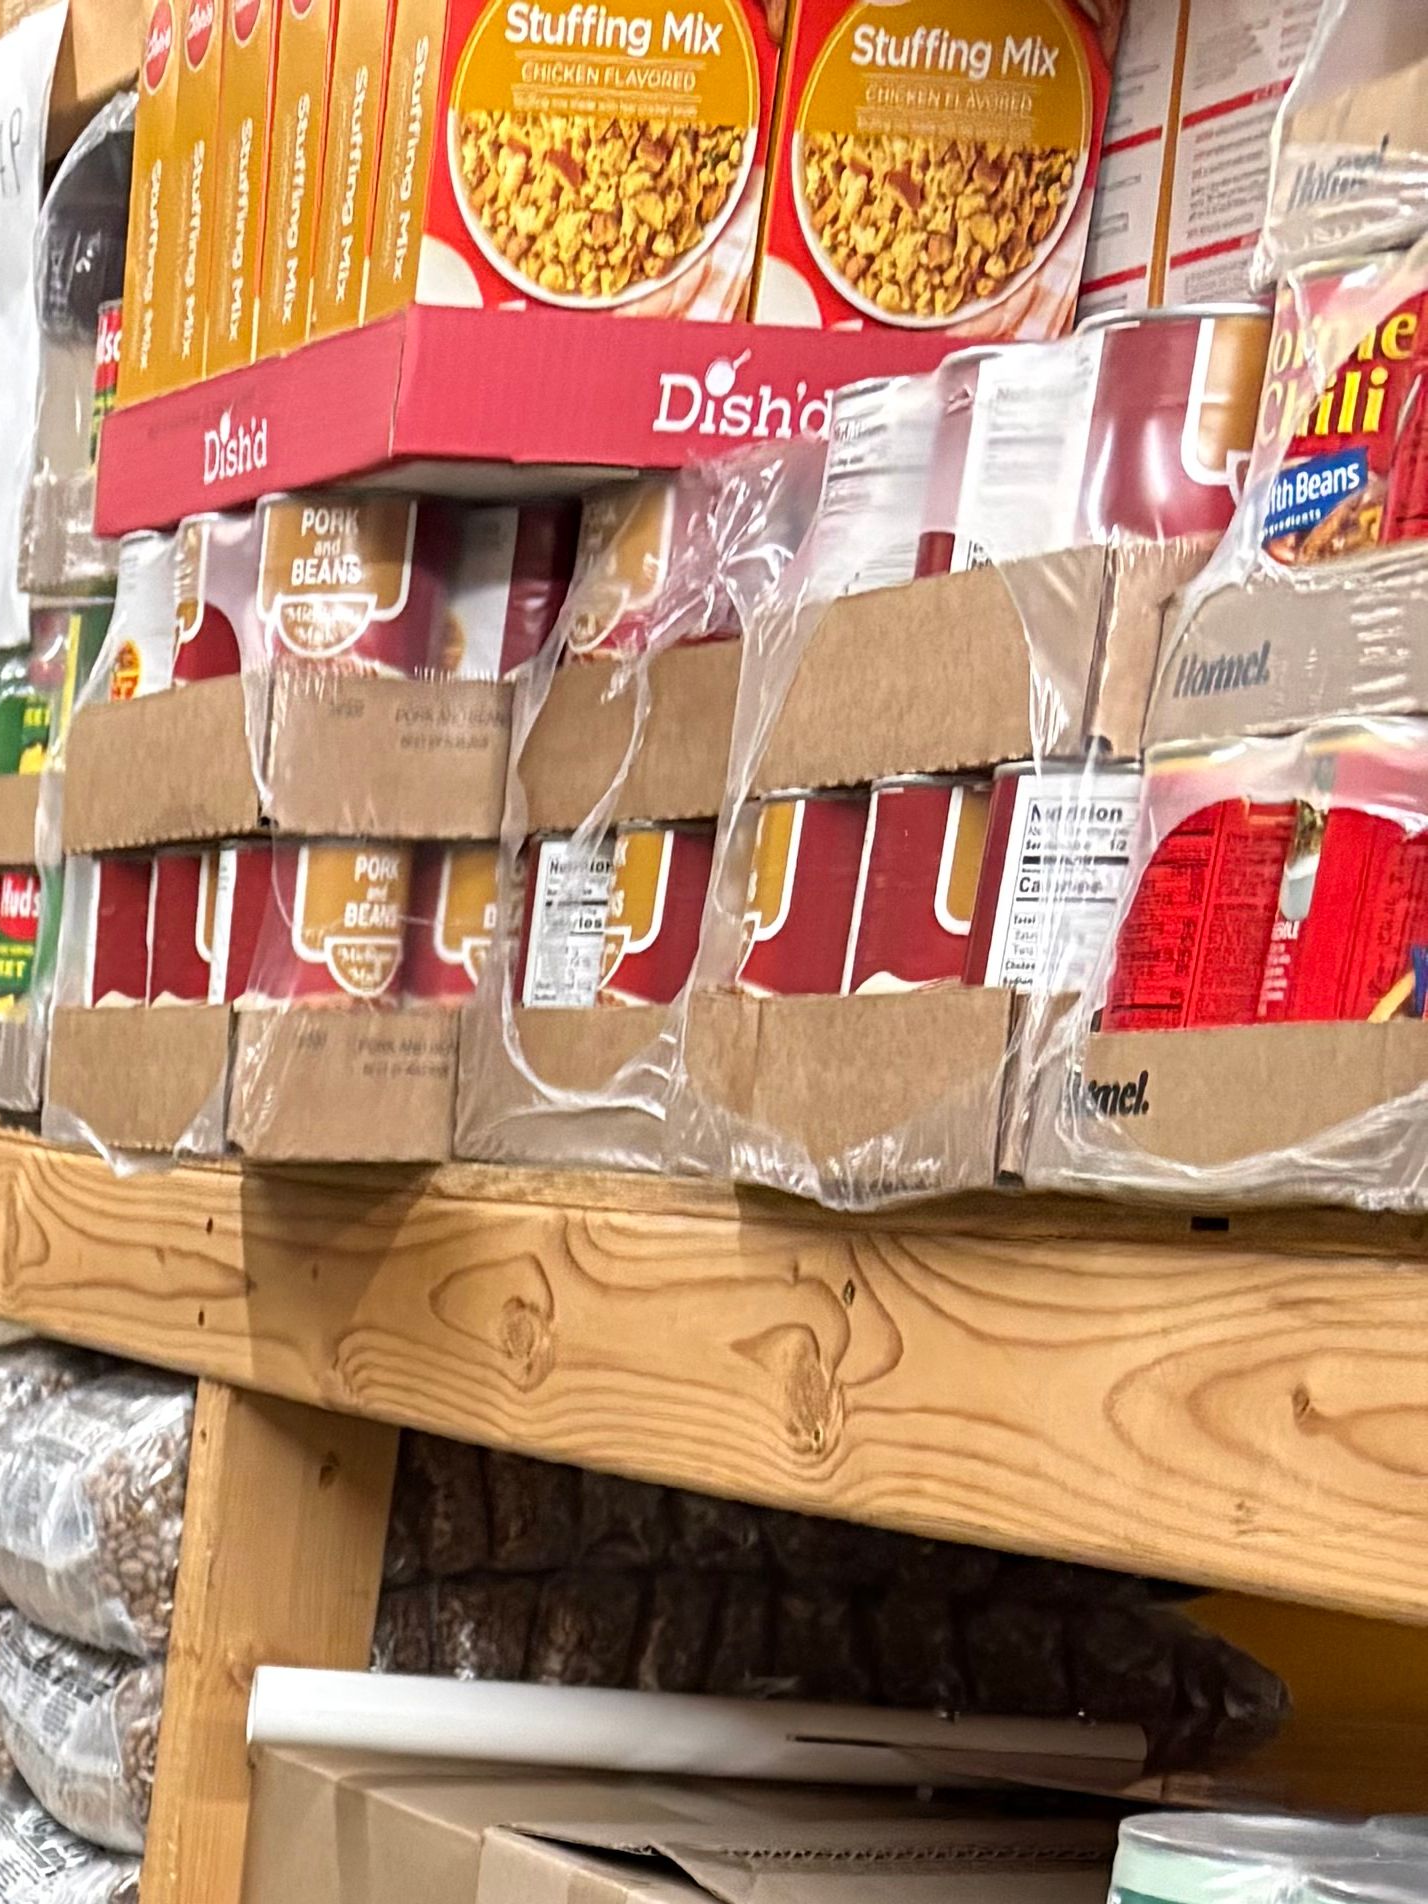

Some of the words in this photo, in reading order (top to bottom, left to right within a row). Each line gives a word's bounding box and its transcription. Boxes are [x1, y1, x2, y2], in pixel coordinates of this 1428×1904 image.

[505, 1, 652, 57] Stuffing
[661, 10, 723, 55] Mix
[851, 23, 992, 80] Stuffing
[1001, 34, 1059, 78] Mix
[521, 61, 600, 85] CHICKEN
[603, 66, 696, 92] FLAVORED
[400, 35, 430, 202] Stuffing
[336, 234, 354, 305] Mix
[393, 210, 411, 281] Mix
[652, 354, 834, 440] Dish'd
[203, 412, 268, 485] Dish'd
[1295, 463, 1359, 504] Beans
[301, 507, 359, 538] PORK
[314, 538, 341, 555] and
[291, 557, 362, 586] BEANS
[355, 854, 400, 882] PORK
[344, 902, 399, 929] BEANS
